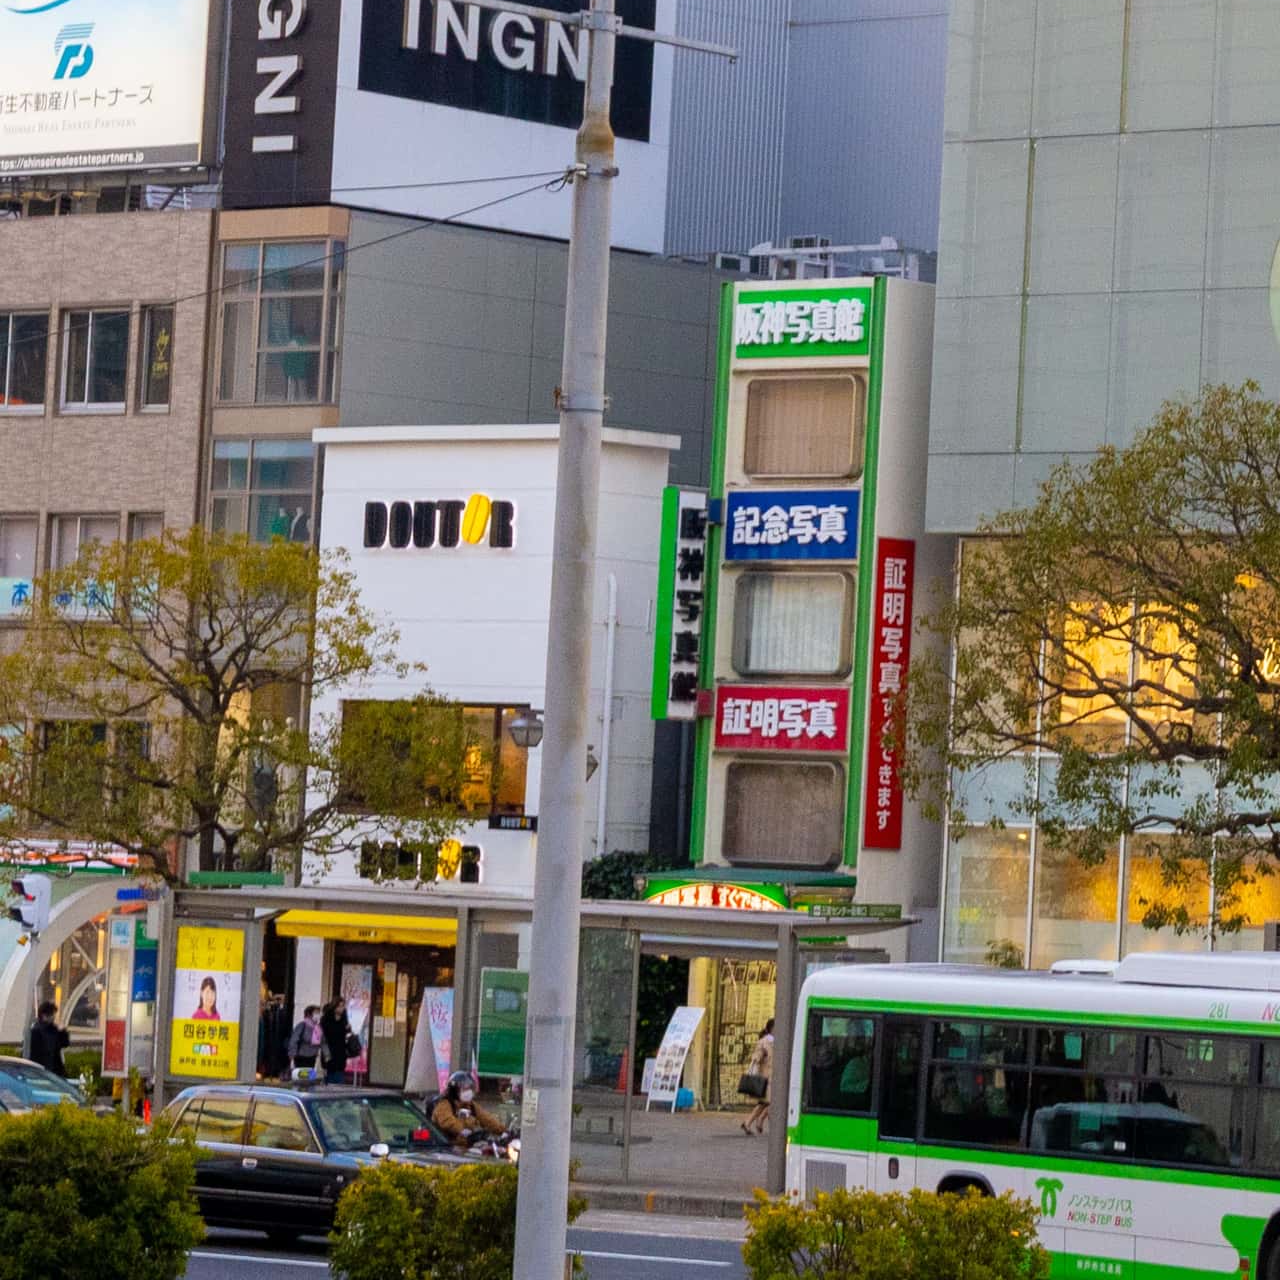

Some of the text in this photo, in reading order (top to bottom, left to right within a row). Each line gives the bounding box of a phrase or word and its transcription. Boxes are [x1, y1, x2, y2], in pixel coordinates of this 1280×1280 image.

[735, 298, 865, 346] 阪神写真館
[732, 505, 848, 544] 記念写真
[722, 697, 837, 739] 証明写真
